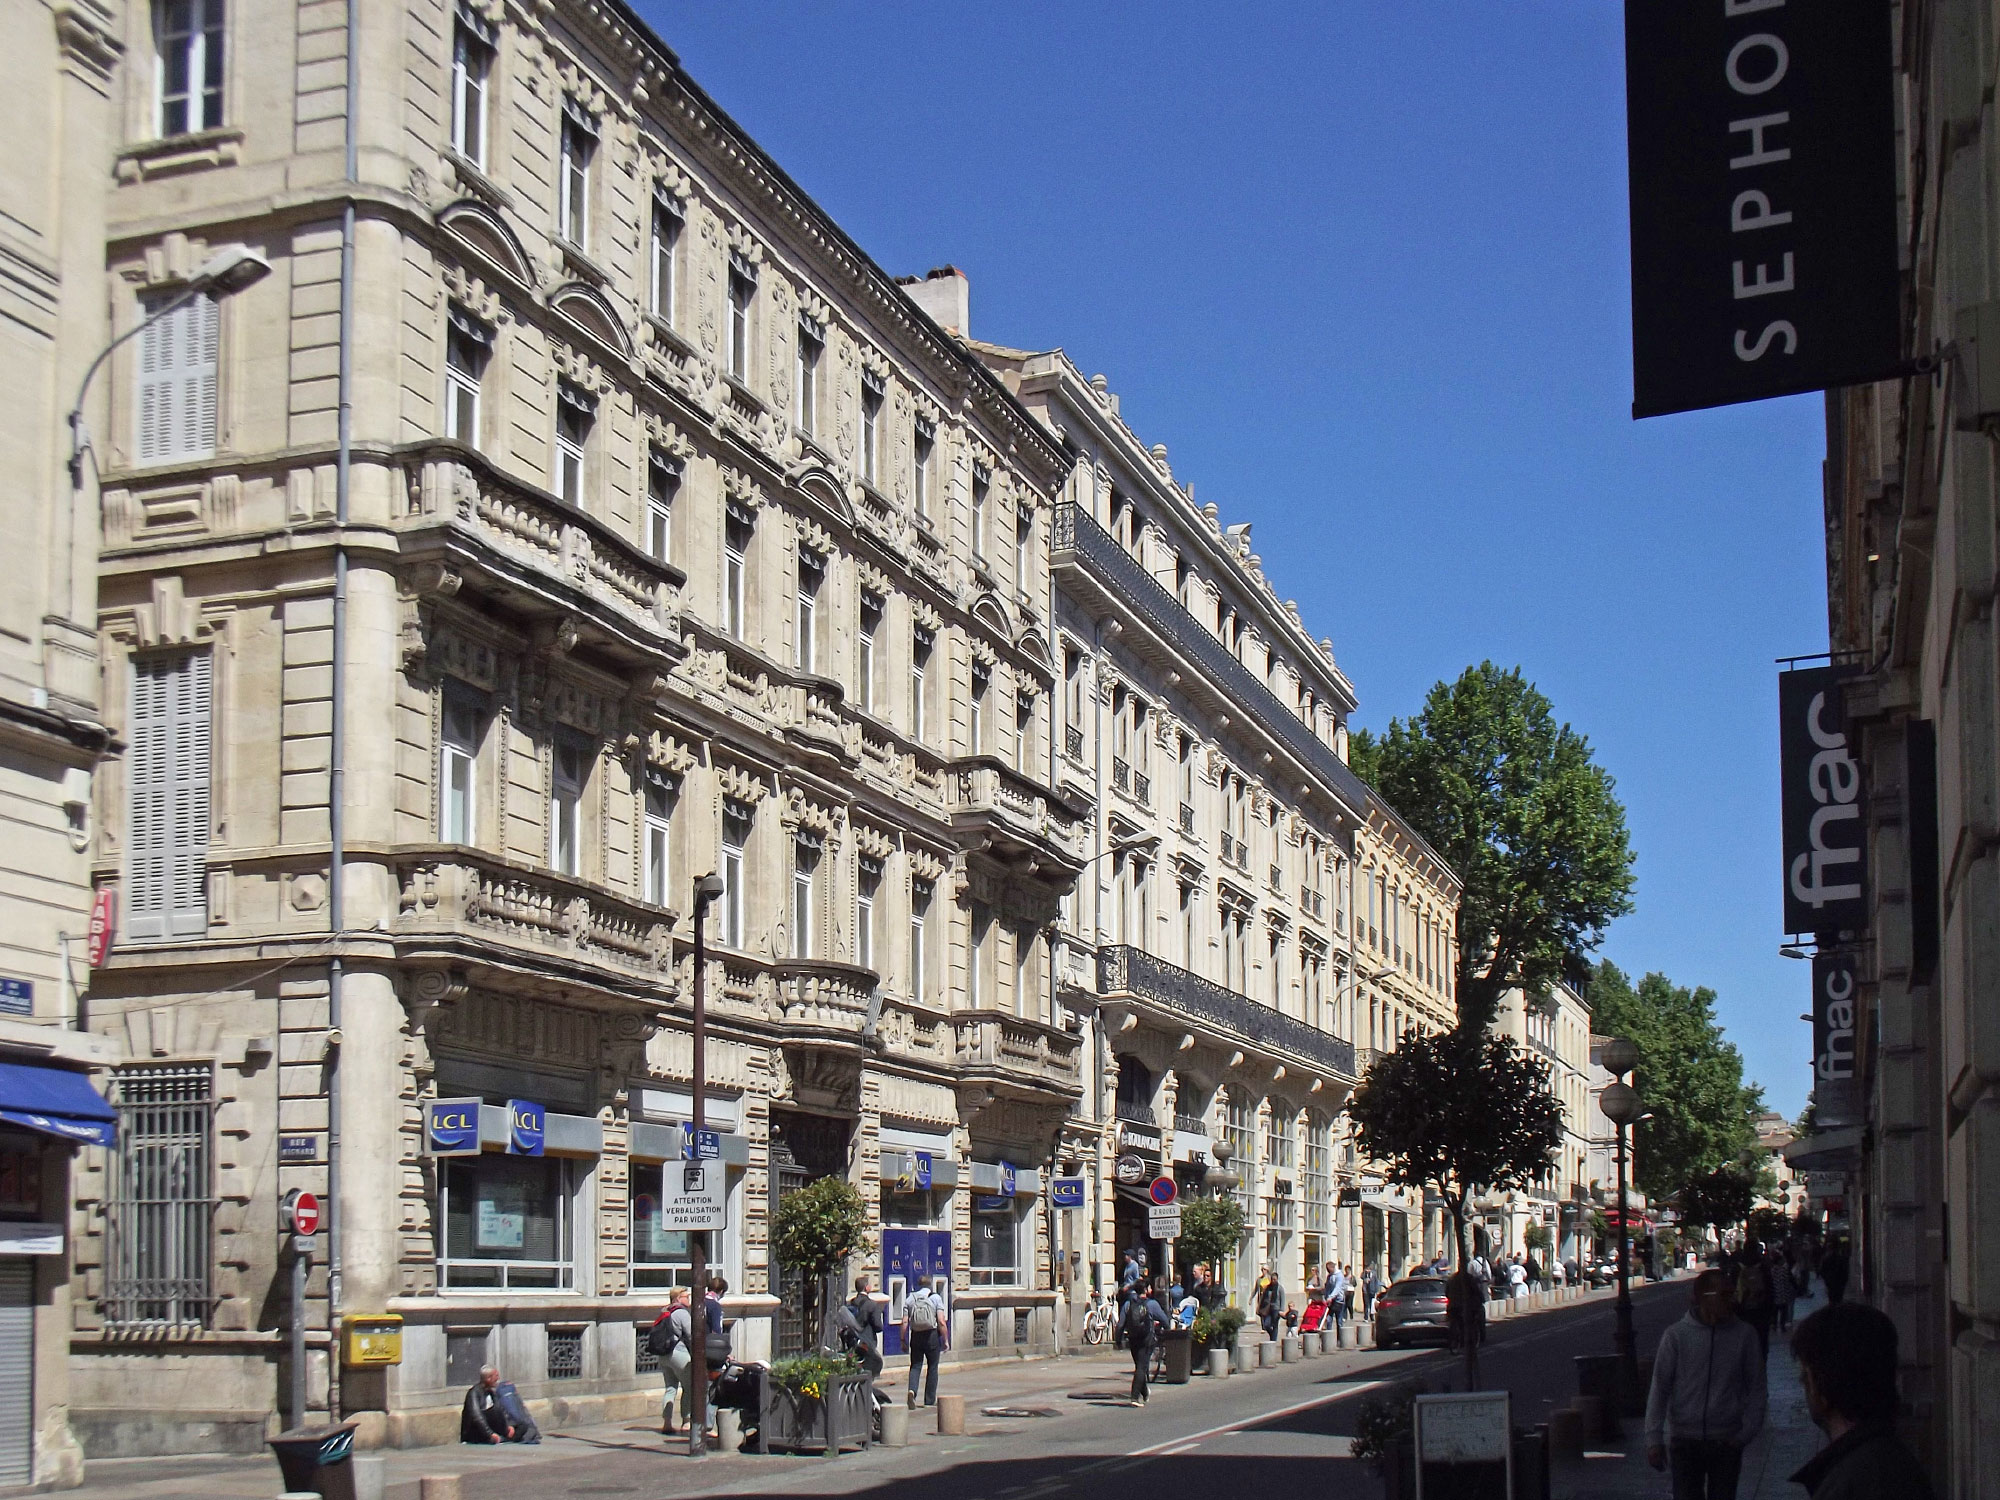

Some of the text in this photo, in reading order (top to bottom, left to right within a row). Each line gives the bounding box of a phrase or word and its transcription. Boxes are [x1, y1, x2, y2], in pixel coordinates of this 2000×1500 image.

[1790, 691, 1862, 910] fnac
[89, 891, 106, 964] TABAC
[1817, 969, 1853, 1082] fnac
[432, 1114, 473, 1129] LCL
[514, 1111, 541, 1131] LCL
[1054, 1185, 1081, 1195] LCL
[666, 1206, 722, 1215] VERBALISATION
[674, 1215, 712, 1224] PAR VIDEO
